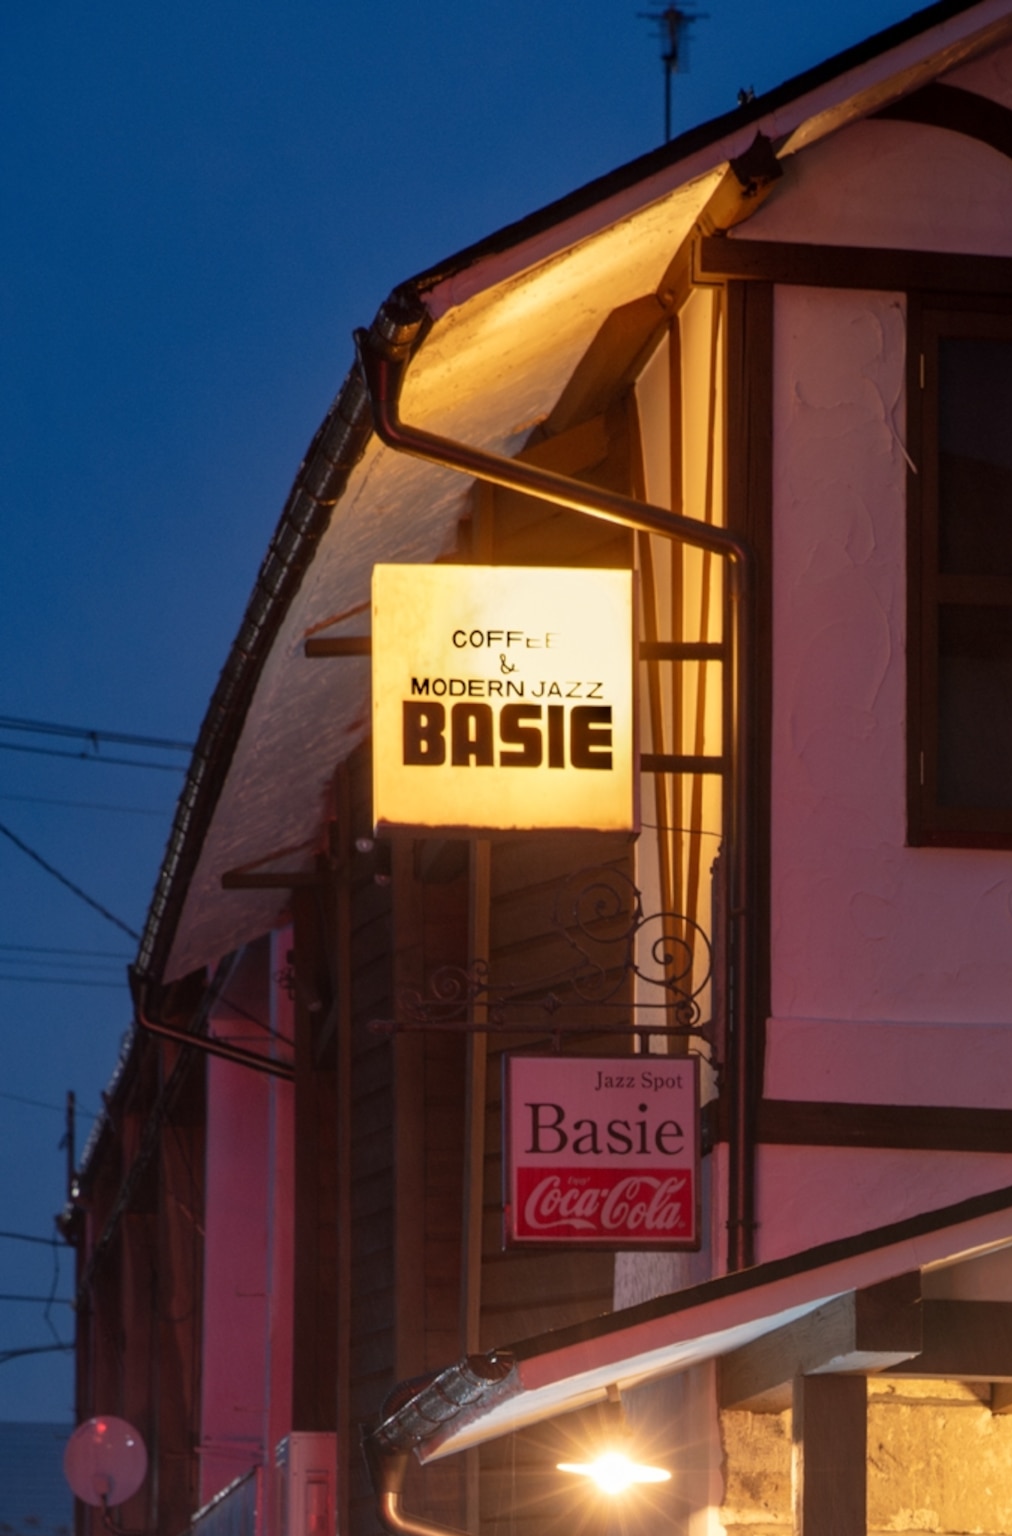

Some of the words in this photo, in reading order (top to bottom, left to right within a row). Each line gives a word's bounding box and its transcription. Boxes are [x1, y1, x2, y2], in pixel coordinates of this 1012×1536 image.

[499, 653, 519, 675] &
[411, 677, 525, 698] MODERN
[531, 681, 604, 699] JAZZ
[402, 700, 613, 771] BASIE
[594, 1070, 636, 1091] Jazz
[641, 1071, 684, 1092] Spot
[523, 1102, 684, 1155] Basie
[524, 1175, 687, 1230] Coca-Cola
